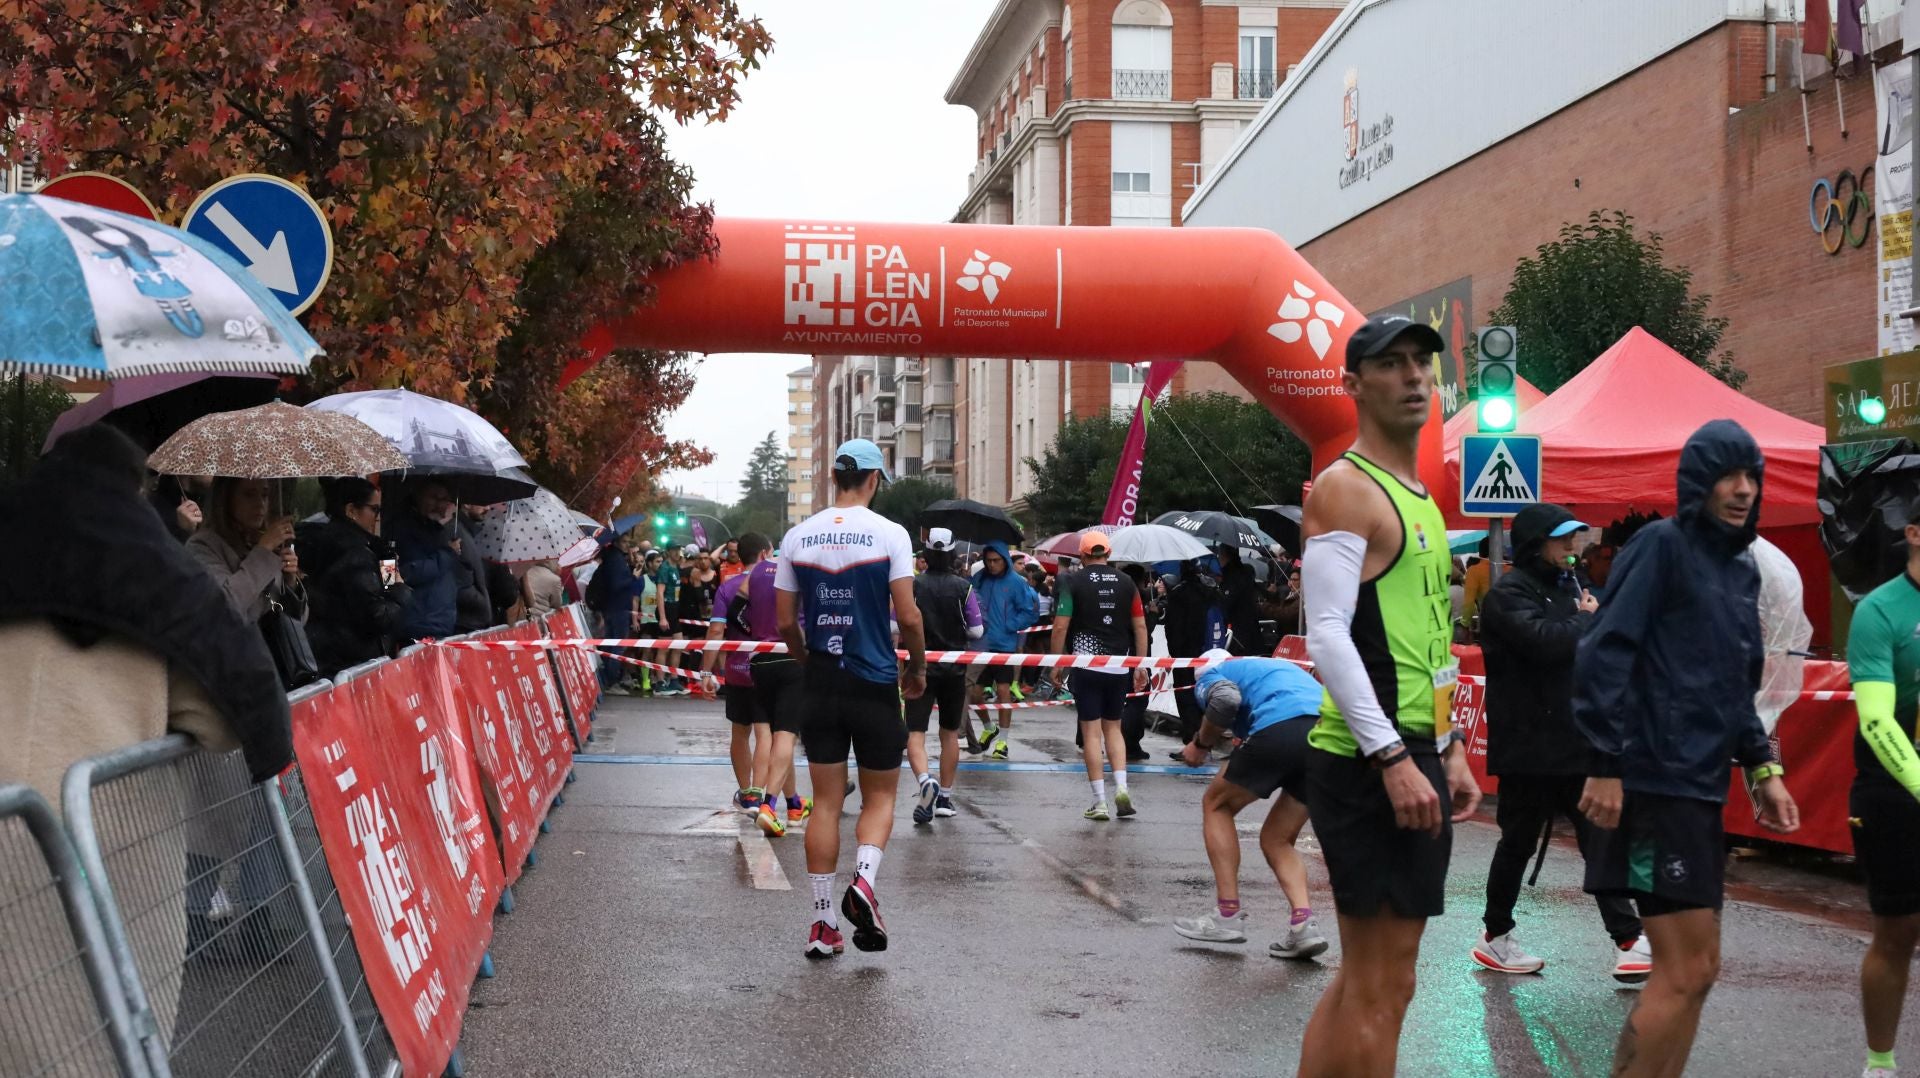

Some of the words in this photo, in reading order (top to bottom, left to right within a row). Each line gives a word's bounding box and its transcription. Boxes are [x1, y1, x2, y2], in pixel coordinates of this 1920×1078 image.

[866, 245, 909, 269] PA
[865, 272, 931, 299] LEN
[864, 302, 922, 327] CIA
[954, 307, 1000, 317] Patronato
[1002, 307, 1047, 318] Municipal
[954, 318, 965, 327] de
[966, 318, 1010, 329] Deportes
[782, 330, 922, 344] AYUNTAMIENTO
[1267, 367, 1335, 380] Patronato
[1269, 383, 1285, 394] de
[1174, 516, 1204, 531] RAIN
[801, 532, 874, 549] TRAGALEGUAS
[1238, 532, 1260, 547] FUC
[1458, 683, 1473, 704] PA
